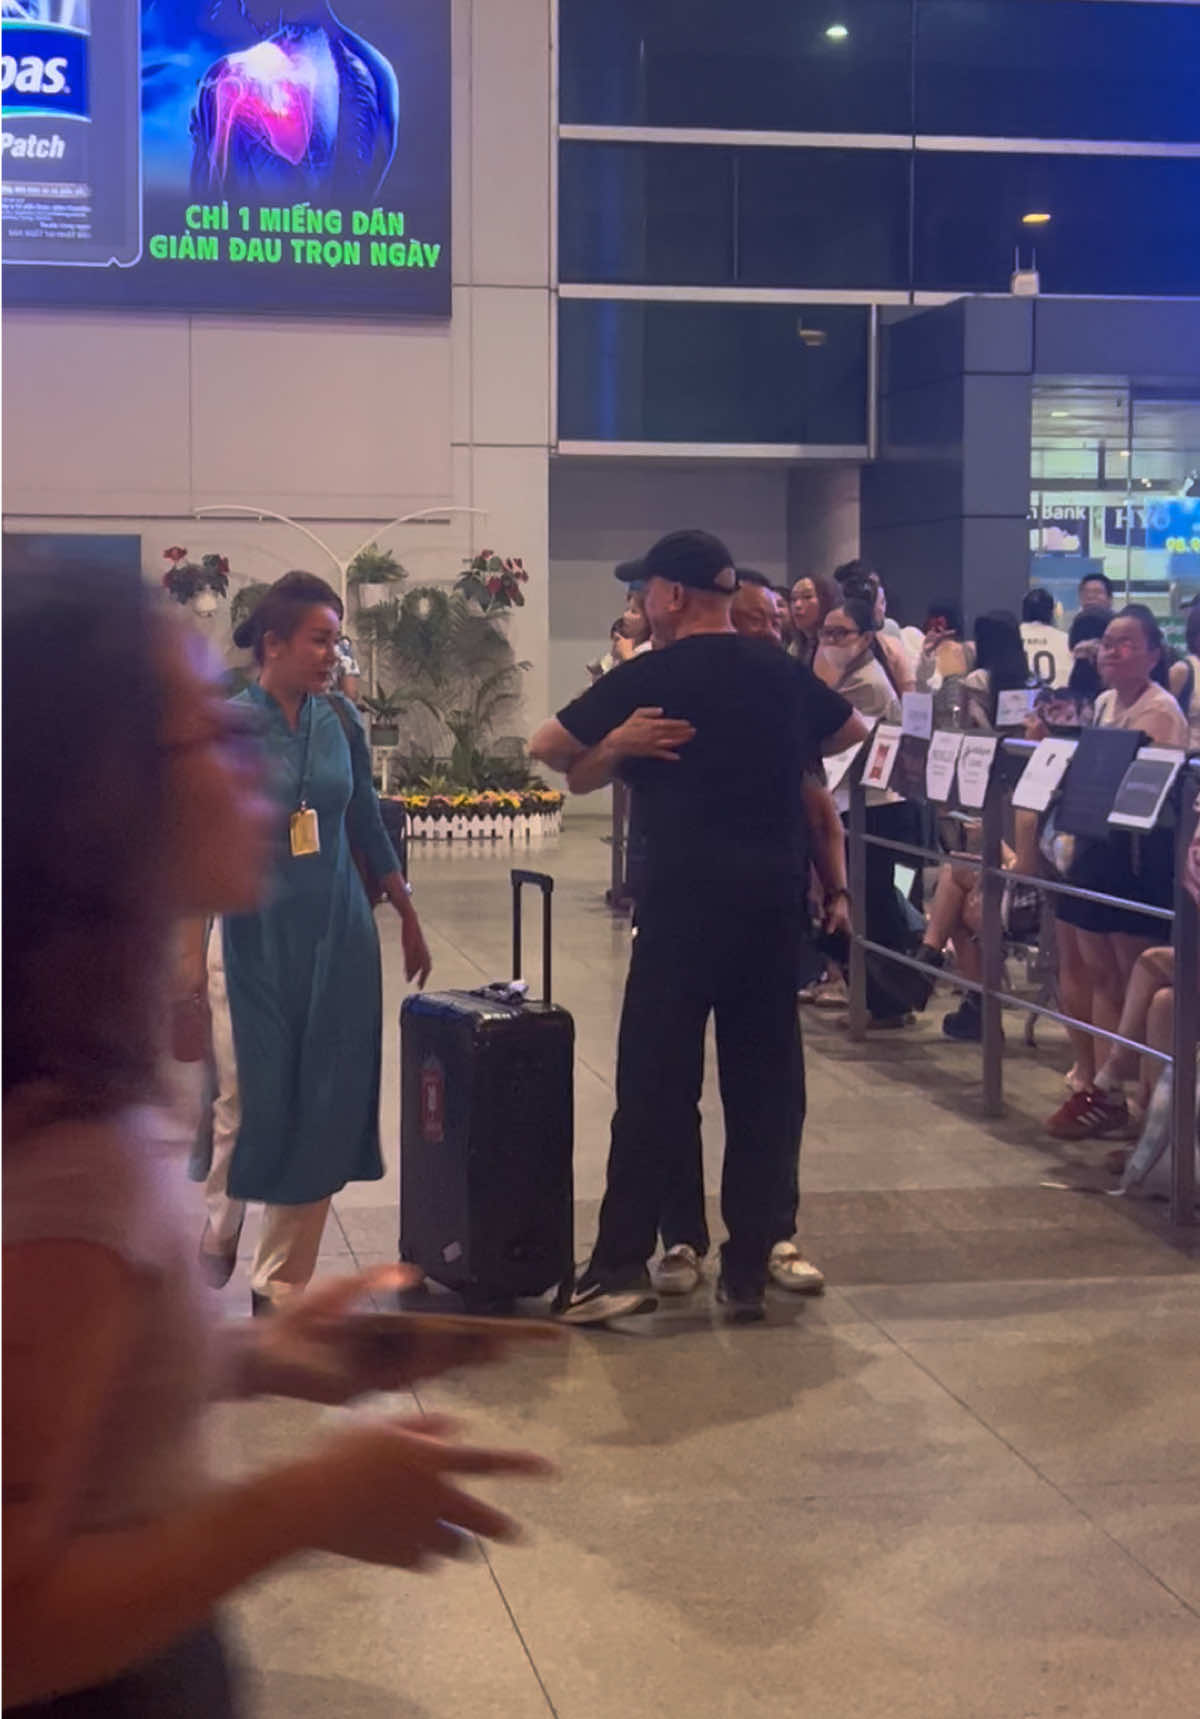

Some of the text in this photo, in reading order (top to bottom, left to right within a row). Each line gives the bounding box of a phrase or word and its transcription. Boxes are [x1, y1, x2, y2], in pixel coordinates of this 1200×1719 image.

[2, 132, 65, 158] Patch
[239, 206, 249, 231] 1
[229, 237, 282, 262] ĐAU
[291, 239, 360, 267] TRỌN
[370, 238, 441, 267] NGÀY
[1042, 505, 1086, 520] Bank
